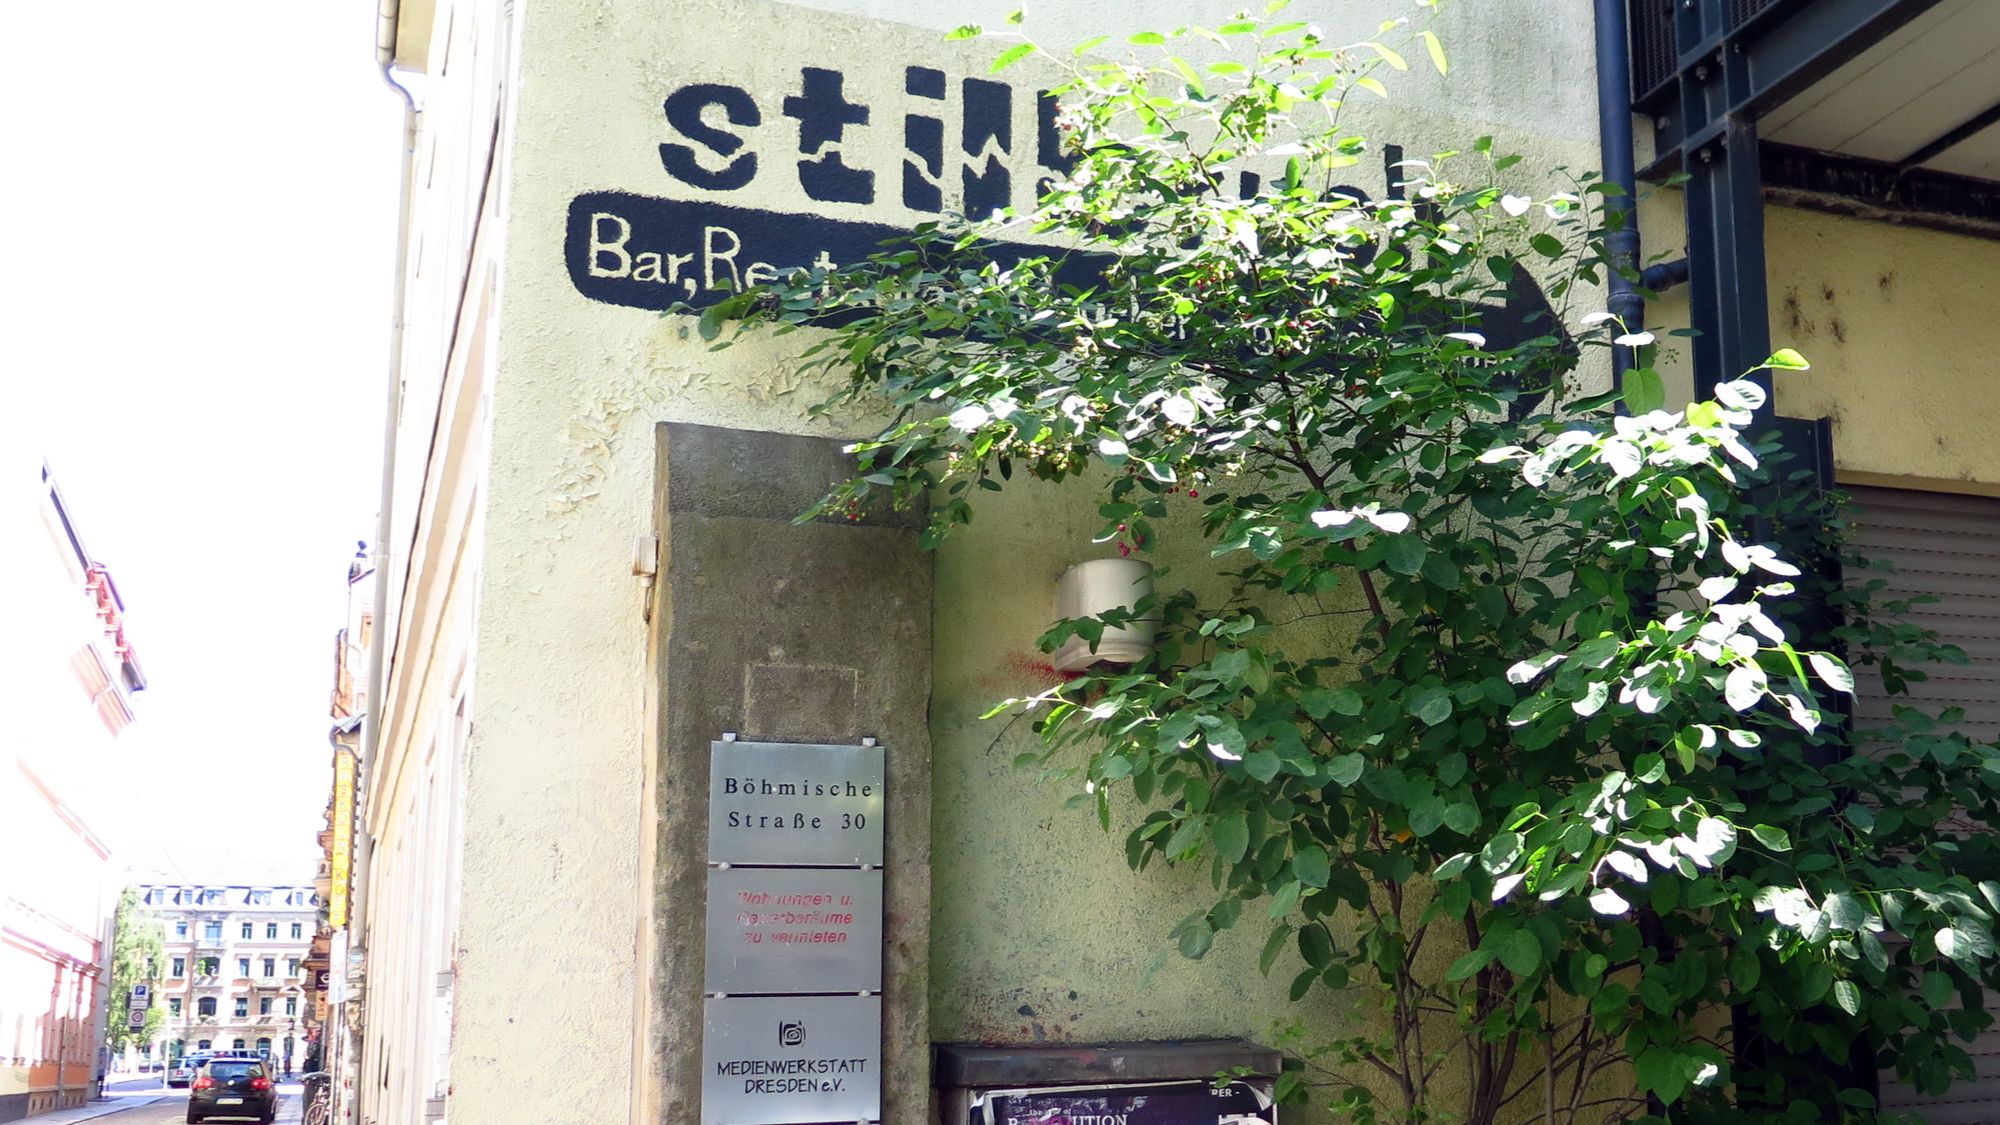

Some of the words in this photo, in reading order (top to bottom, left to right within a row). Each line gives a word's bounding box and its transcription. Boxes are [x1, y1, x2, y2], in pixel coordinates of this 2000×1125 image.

[724, 778, 873, 797] Böhmische
[728, 811, 822, 829] Straße
[841, 813, 866, 829] 30
[840, 894, 854, 906] u.
[737, 911, 853, 925] Geerberäume
[744, 932, 763, 944] zu
[771, 931, 848, 944] vermieten
[717, 1058, 867, 1076] MEDIENWERKSTATT
[744, 1078, 818, 1094] DRESDEN
[821, 1078, 846, 1092] e.V.
